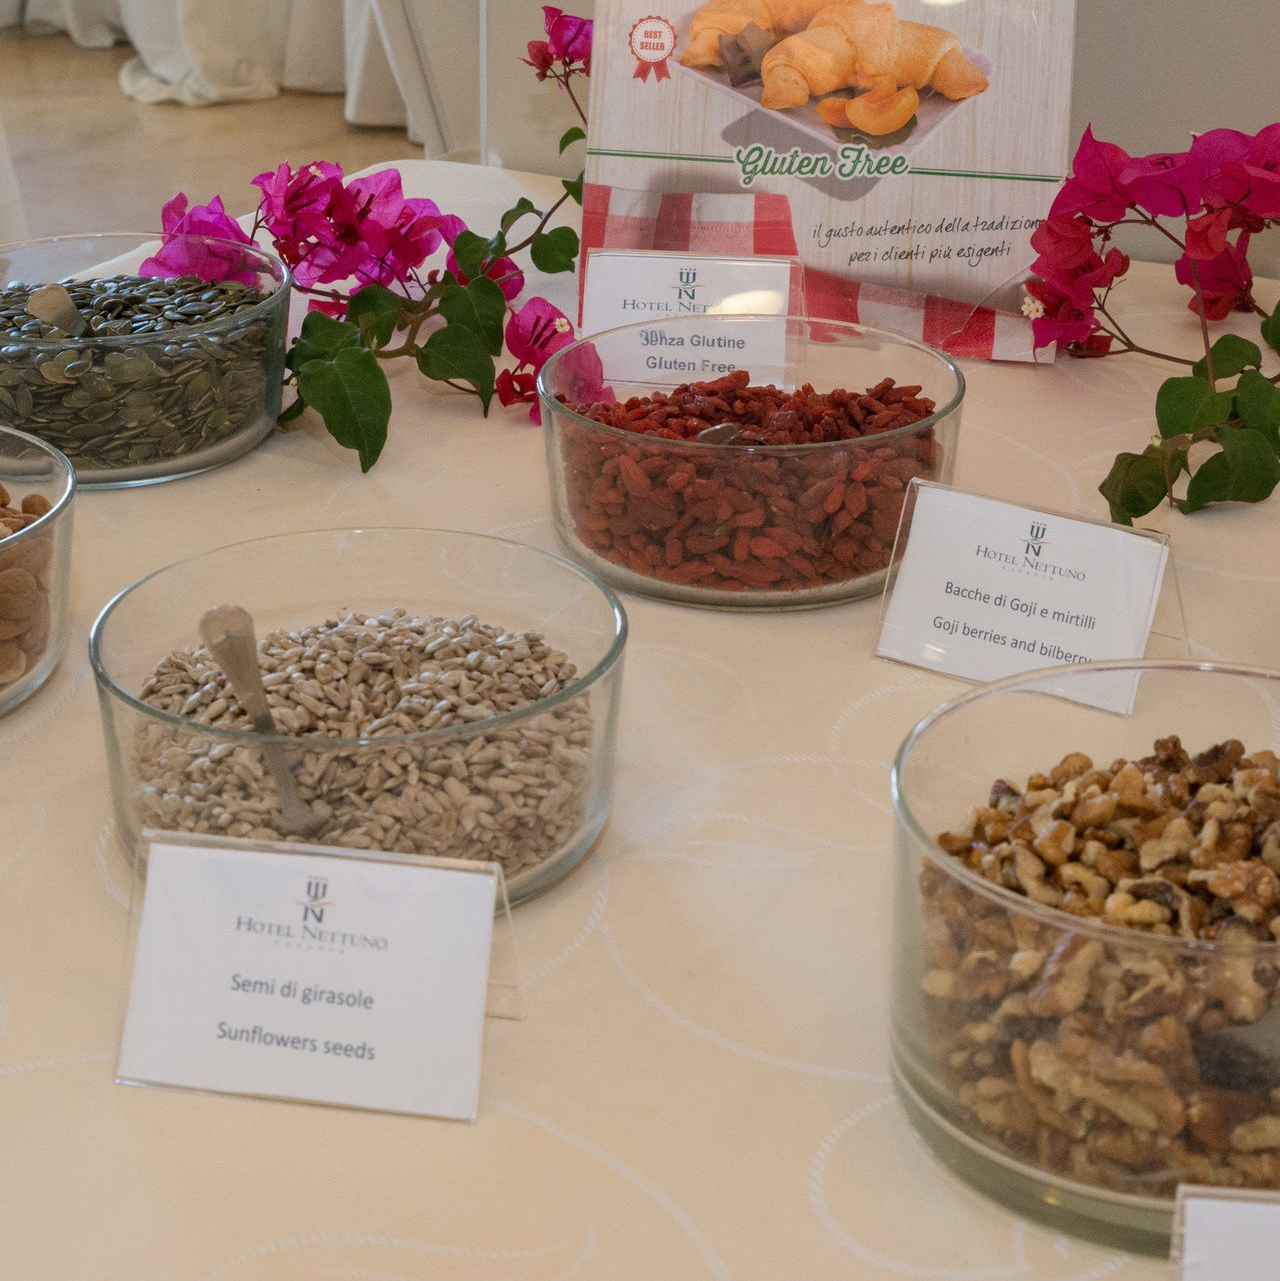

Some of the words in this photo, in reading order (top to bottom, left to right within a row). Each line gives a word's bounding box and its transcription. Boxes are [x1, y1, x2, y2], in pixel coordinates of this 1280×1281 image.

[640, 41, 665, 51] SELLER
[643, 30, 663, 39] BEST
[736, 146, 833, 185] Gluten
[837, 145, 910, 178] Free
[817, 221, 863, 248] gusto
[867, 218, 932, 237] autentico
[935, 216, 971, 233] della
[972, 215, 1046, 232] tradizion
[881, 245, 926, 261] clienti
[956, 240, 1012, 268] esigenti
[623, 299, 673, 312] HOTEL
[690, 334, 746, 350] Glutine
[646, 355, 696, 372] Gluten
[701, 359, 736, 373] Free
[975, 545, 1018, 566] HOTEL
[1022, 557, 1086, 581] NETTUNO
[944, 581, 991, 604] Bacche
[994, 594, 1008, 608] di
[1010, 597, 1038, 617] Goji
[1040, 607, 1049, 619] e
[1052, 610, 1097, 630] mirtilli
[933, 616, 960, 635] Goji
[962, 622, 1008, 646] berries
[1010, 640, 1037, 653] and
[235, 915, 295, 939] HOTEL
[301, 923, 389, 951] NETTUNO
[230, 973, 276, 996] Semi
[280, 980, 297, 999] di
[301, 984, 375, 1010] girasole
[216, 1021, 319, 1053] Sunflowers
[323, 1040, 376, 1061] seeds
